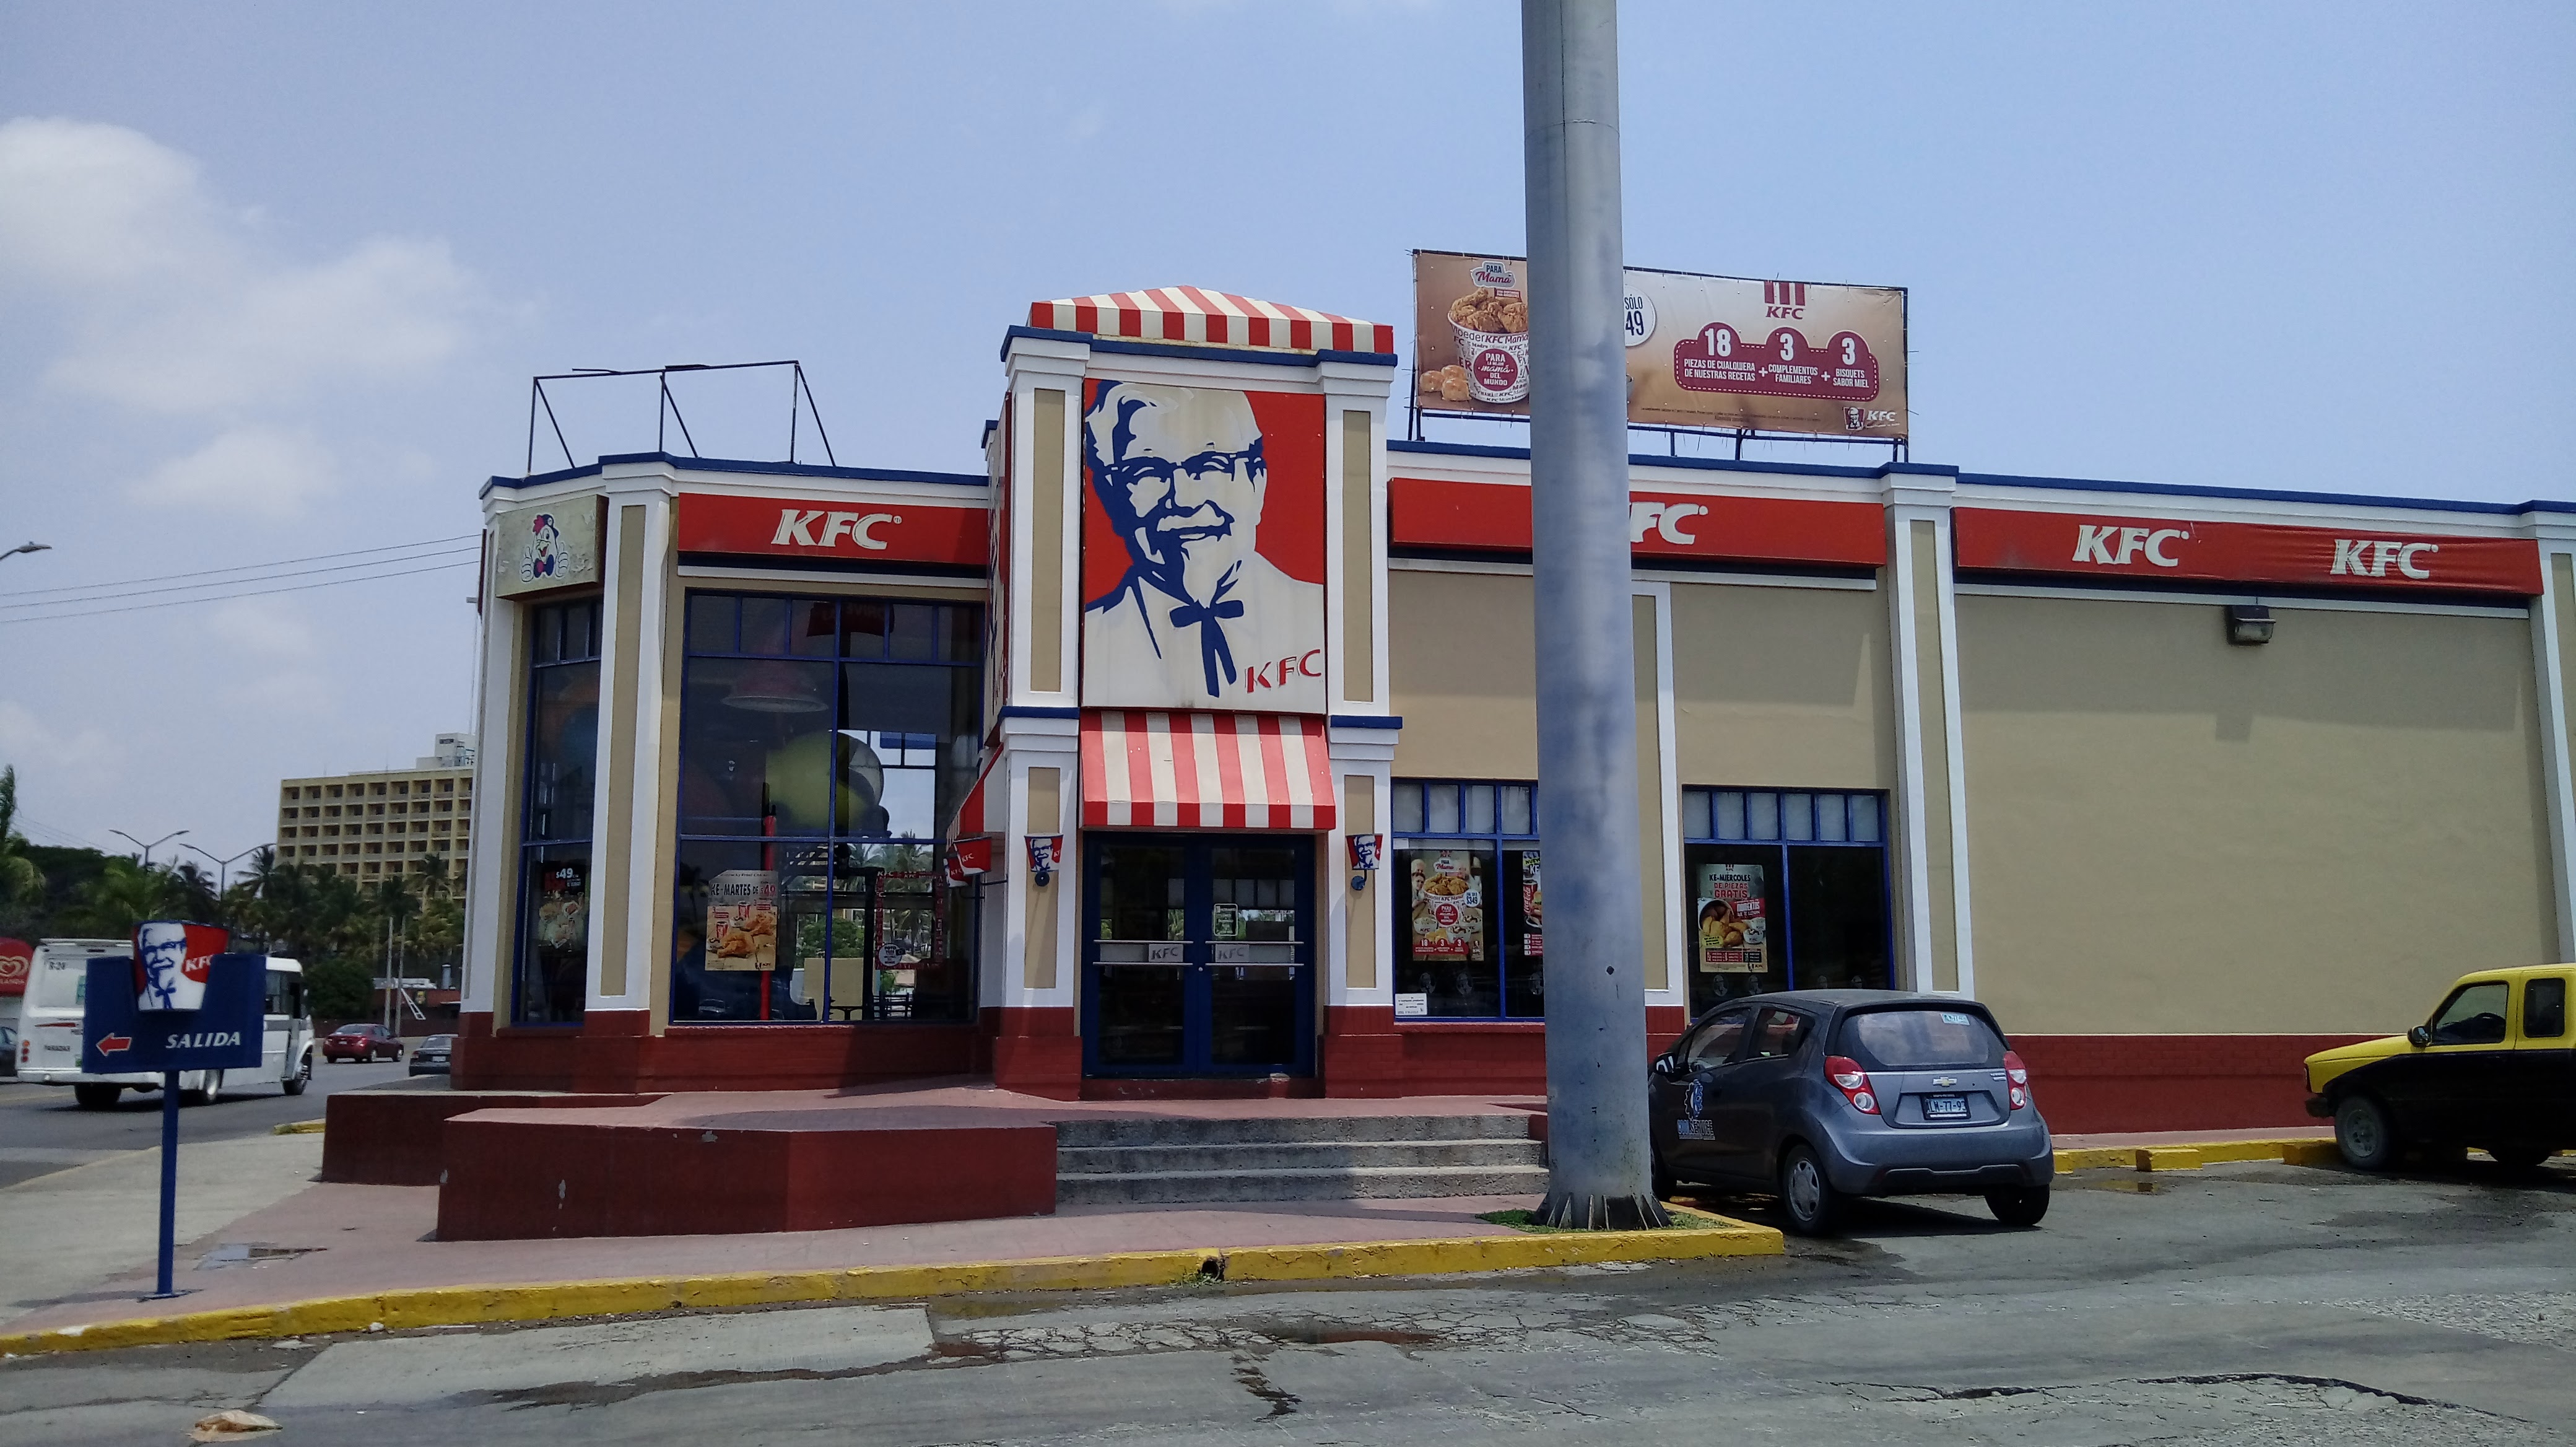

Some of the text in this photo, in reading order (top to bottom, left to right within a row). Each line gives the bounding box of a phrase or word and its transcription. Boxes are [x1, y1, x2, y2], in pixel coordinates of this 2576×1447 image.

[1765, 306, 1804, 320] KFC
[1485, 335, 1503, 344] KFC
[1705, 328, 1731, 357] 18
[1780, 333, 1794, 361] 3
[1842, 338, 1856, 365] 3
[1486, 353, 1505, 362] PARA
[1481, 365, 1510, 373] mamá
[1684, 359, 1706, 369] PIEZAS
[1707, 360, 1716, 369] DE
[1768, 364, 1818, 376] COMPLEMENTOS
[1684, 369, 1756, 382] DE NUESTRAS RECETAS
[1775, 374, 1812, 385] FAMILIARES
[1835, 369, 1865, 378] BISQUETS
[1833, 378, 1869, 388] SABOR MIEL
[1866, 410, 1897, 422] KFC
[770, 508, 893, 550] KFC
[1629, 501, 1699, 545] FC
[2071, 524, 2182, 567] KFC
[2330, 538, 2432, 579] KFC
[1245, 649, 1321, 694] KFC
[961, 853, 974, 863] KFC
[556, 868, 573, 878] $49
[753, 886, 759, 894] DE
[1714, 890, 1748, 898] GRATIS
[1151, 946, 1179, 960] KFC
[1218, 947, 1245, 960] KFC
[165, 1031, 241, 1049] SALIDA
